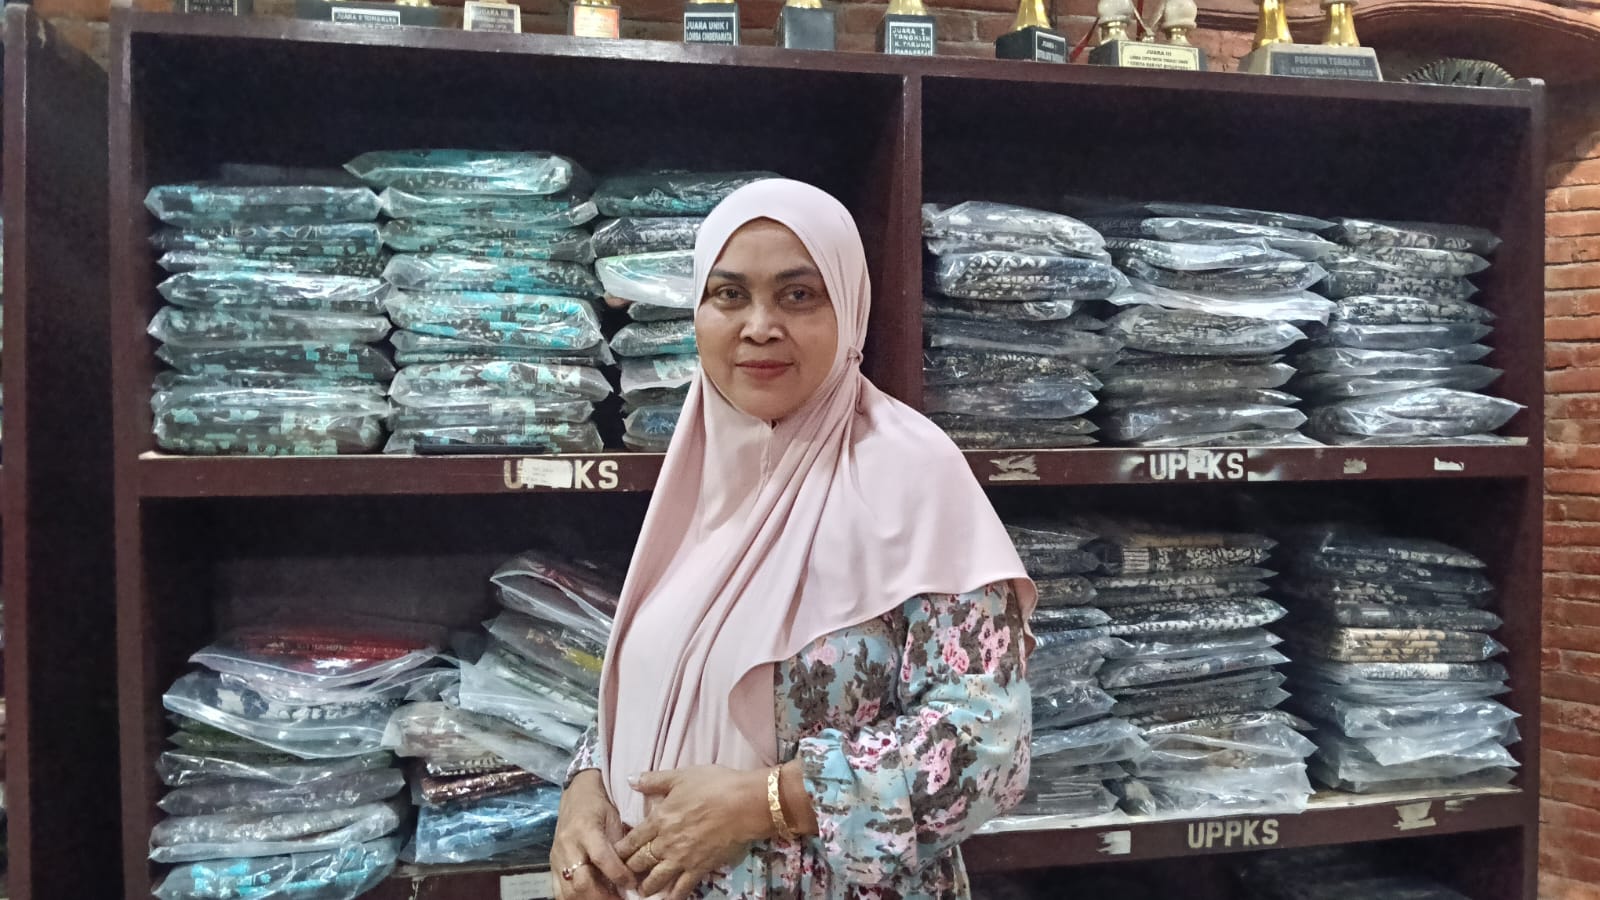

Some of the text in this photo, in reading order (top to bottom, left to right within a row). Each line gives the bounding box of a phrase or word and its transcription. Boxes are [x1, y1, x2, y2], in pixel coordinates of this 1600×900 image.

[686, 21, 708, 30] JUARA
[708, 21, 725, 30] UNIK
[892, 27, 916, 35] JUARA
[503, 458, 619, 490] UKS
[1188, 818, 1279, 849] UPPKS
